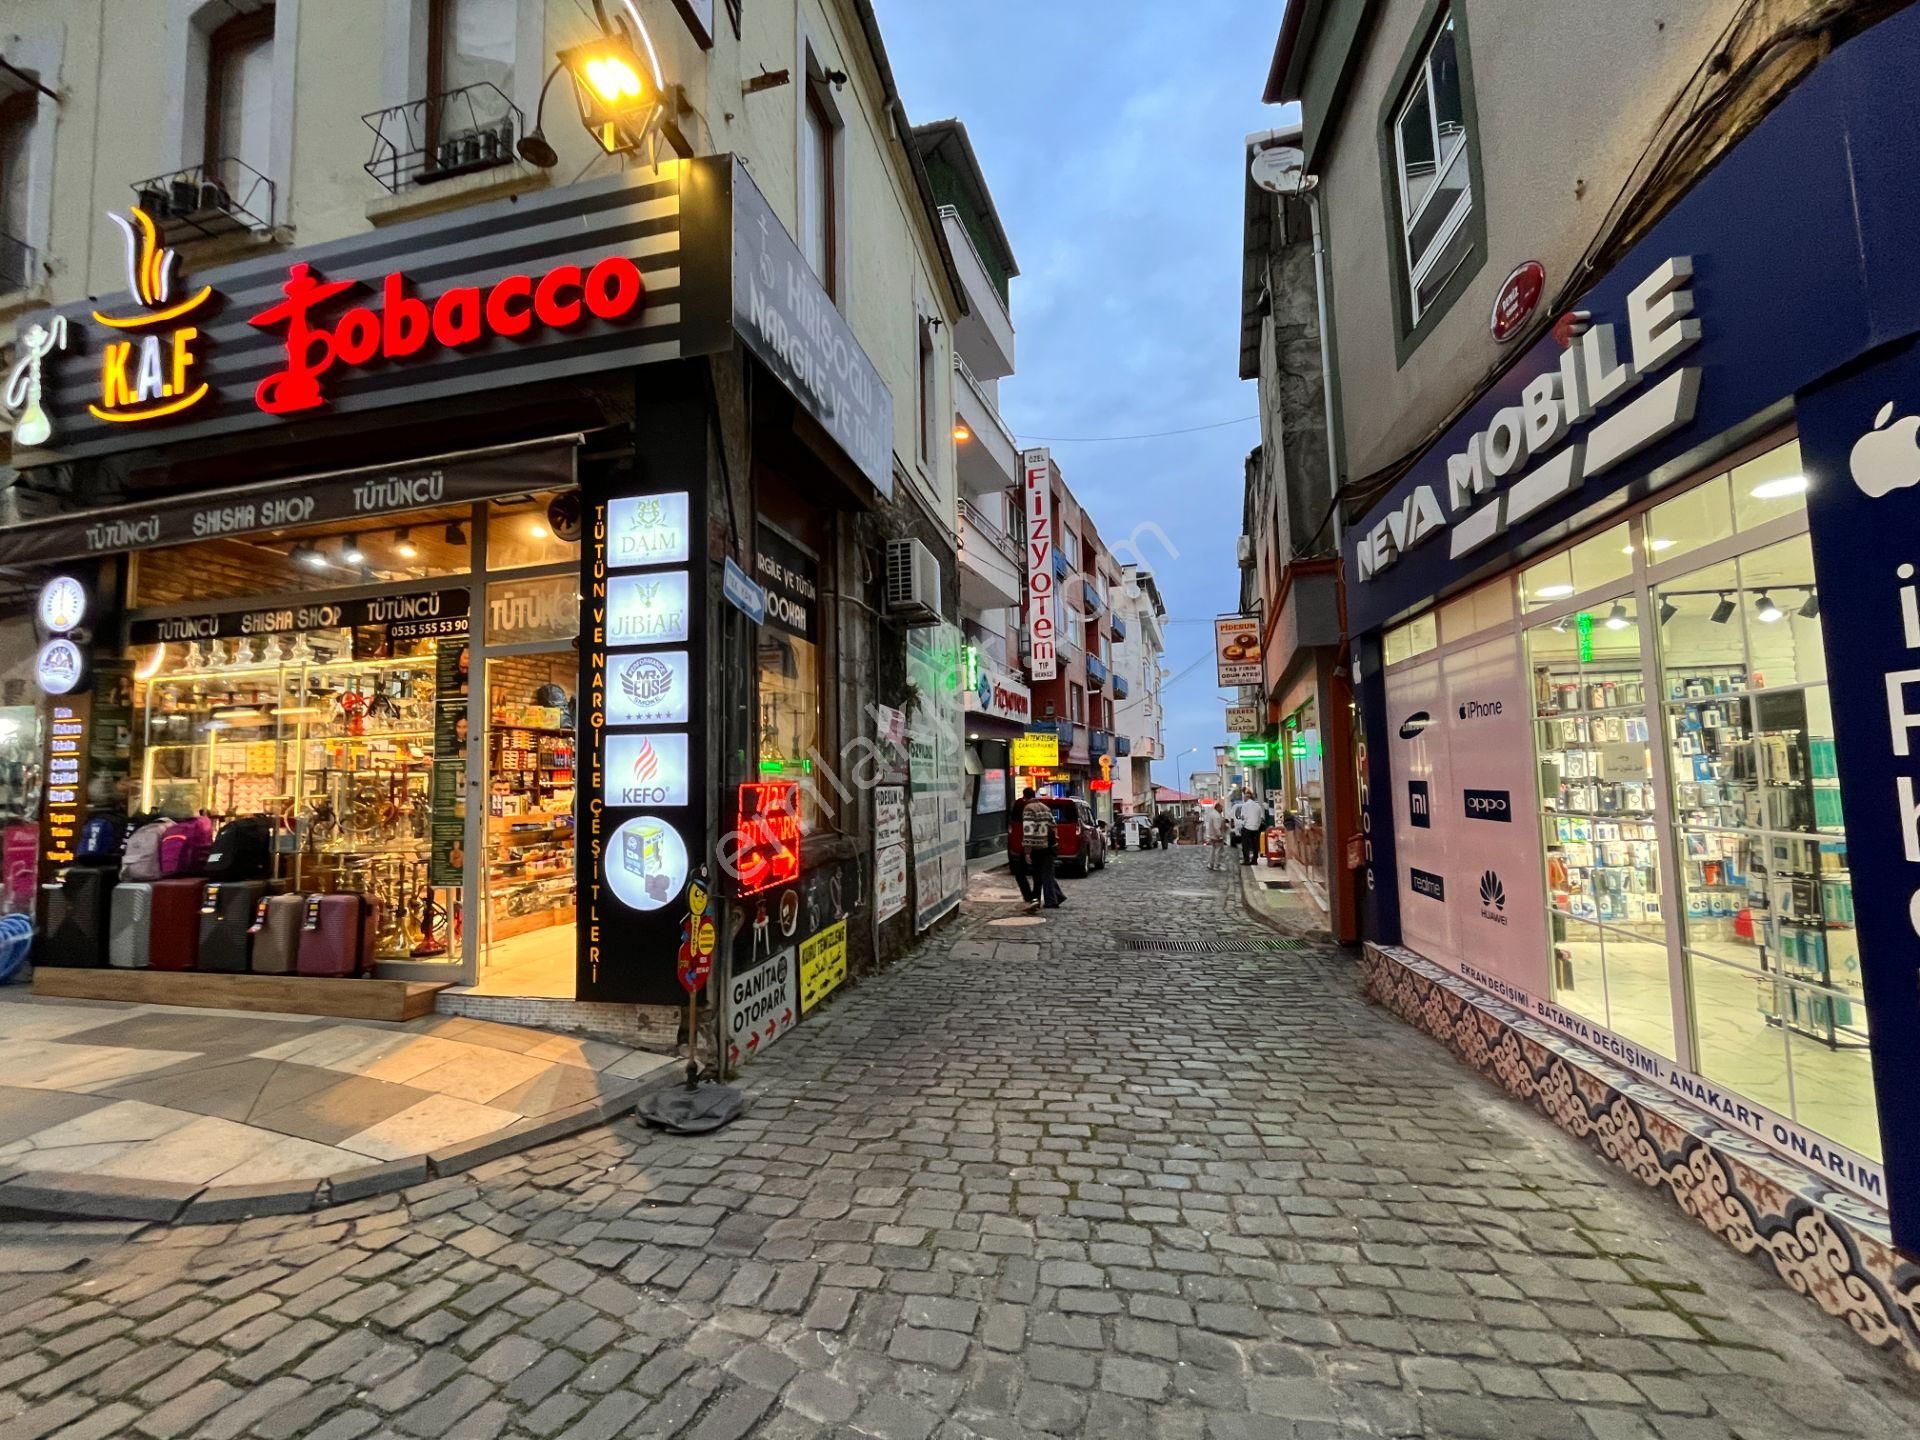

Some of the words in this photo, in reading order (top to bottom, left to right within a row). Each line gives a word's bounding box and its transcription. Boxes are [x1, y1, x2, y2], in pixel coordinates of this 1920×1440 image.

[749, 270, 827, 409] NARGİLE
[830, 381, 851, 438] VE
[86, 515, 160, 550] TÜTÜNCÜ
[192, 504, 256, 538] SHISHA
[260, 496, 315, 526] SHOP
[352, 470, 444, 511] TÜTÜNCÜ
[592, 505, 605, 598] TÜTÜN
[1356, 485, 1447, 584] NEVA
[784, 568, 795, 590] VE
[158, 616, 219, 640] TÜTÜNCÜ
[241, 610, 293, 634] SHISHA
[297, 605, 342, 628] SHOP
[367, 592, 440, 622] TÜTÜNCÜ
[391, 624, 416, 638] 0535
[418, 622, 438, 635] 555
[439, 620, 453, 634] 53
[454, 618, 468, 632] 90
[593, 608, 605, 643] VE
[590, 652, 604, 788] NARGİLE
[621, 787, 666, 804] KEFO
[1467, 796, 1507, 812] oppo
[1413, 874, 1441, 897] realme
[1480, 907, 1508, 926] HUAWEI
[733, 964, 777, 1005] GANİTA
[733, 982, 787, 1033] OTOPARK
[1460, 962, 1488, 986] EKRAN
[1537, 1001, 1589, 1041] BATARYA
[1669, 1070, 1764, 1132] ANAKART
[1772, 1123, 1882, 1197] ONARIM
